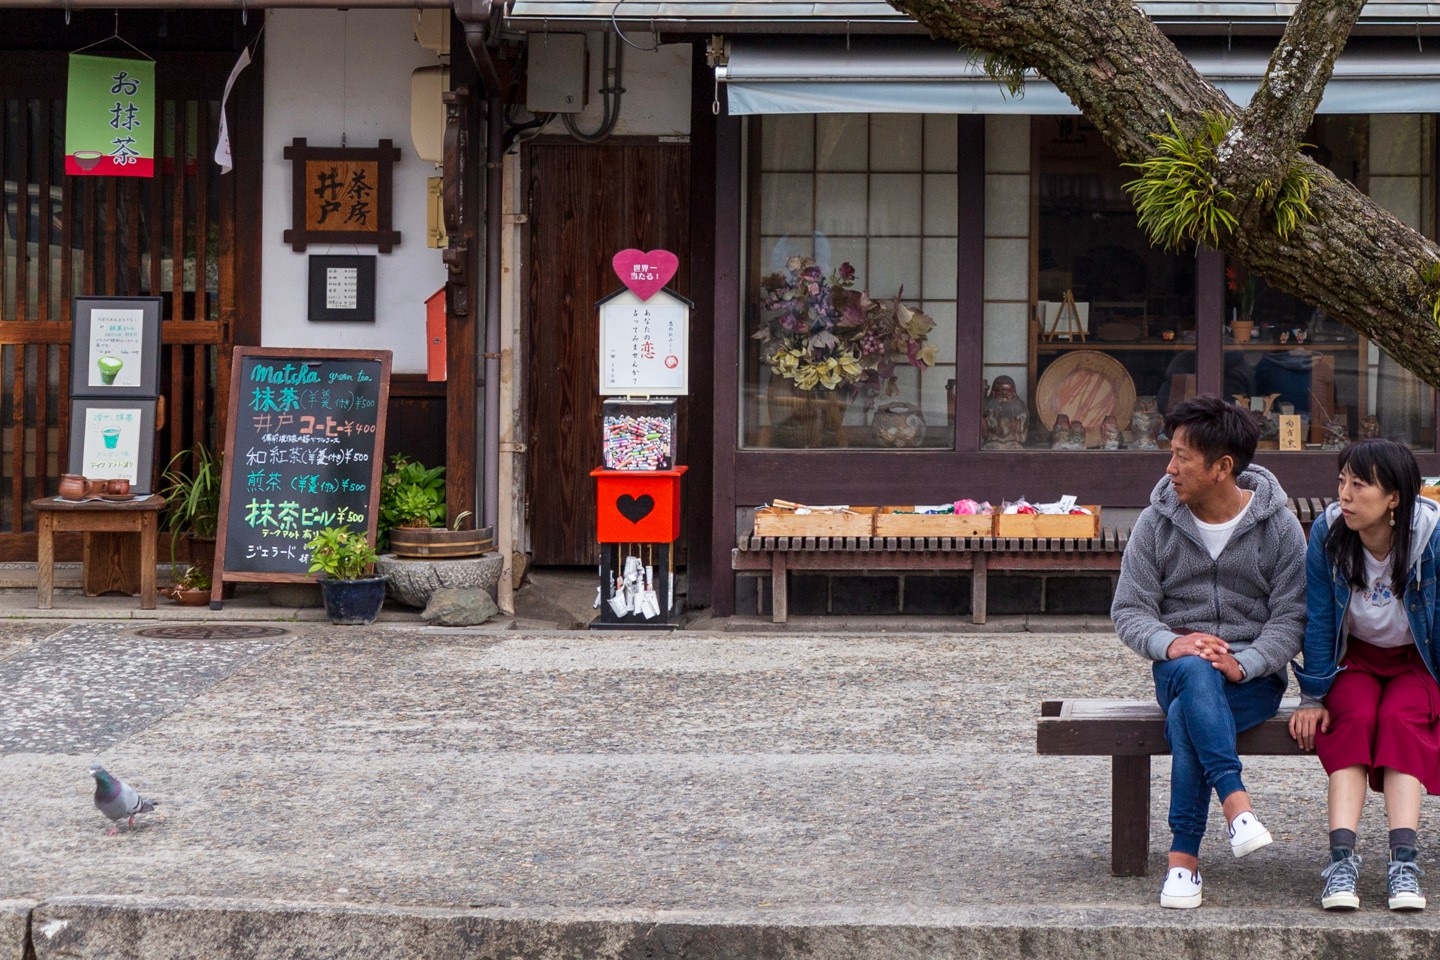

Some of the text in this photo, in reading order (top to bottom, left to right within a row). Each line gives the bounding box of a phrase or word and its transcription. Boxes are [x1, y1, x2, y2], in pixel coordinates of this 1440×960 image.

[109, 71, 141, 165] お抹茶
[313, 166, 345, 224] 井戸
[343, 168, 374, 225] 茶房
[633, 264, 658, 272] 世界一
[640, 309, 655, 360] あなたの恋
[329, 372, 354, 384] green
